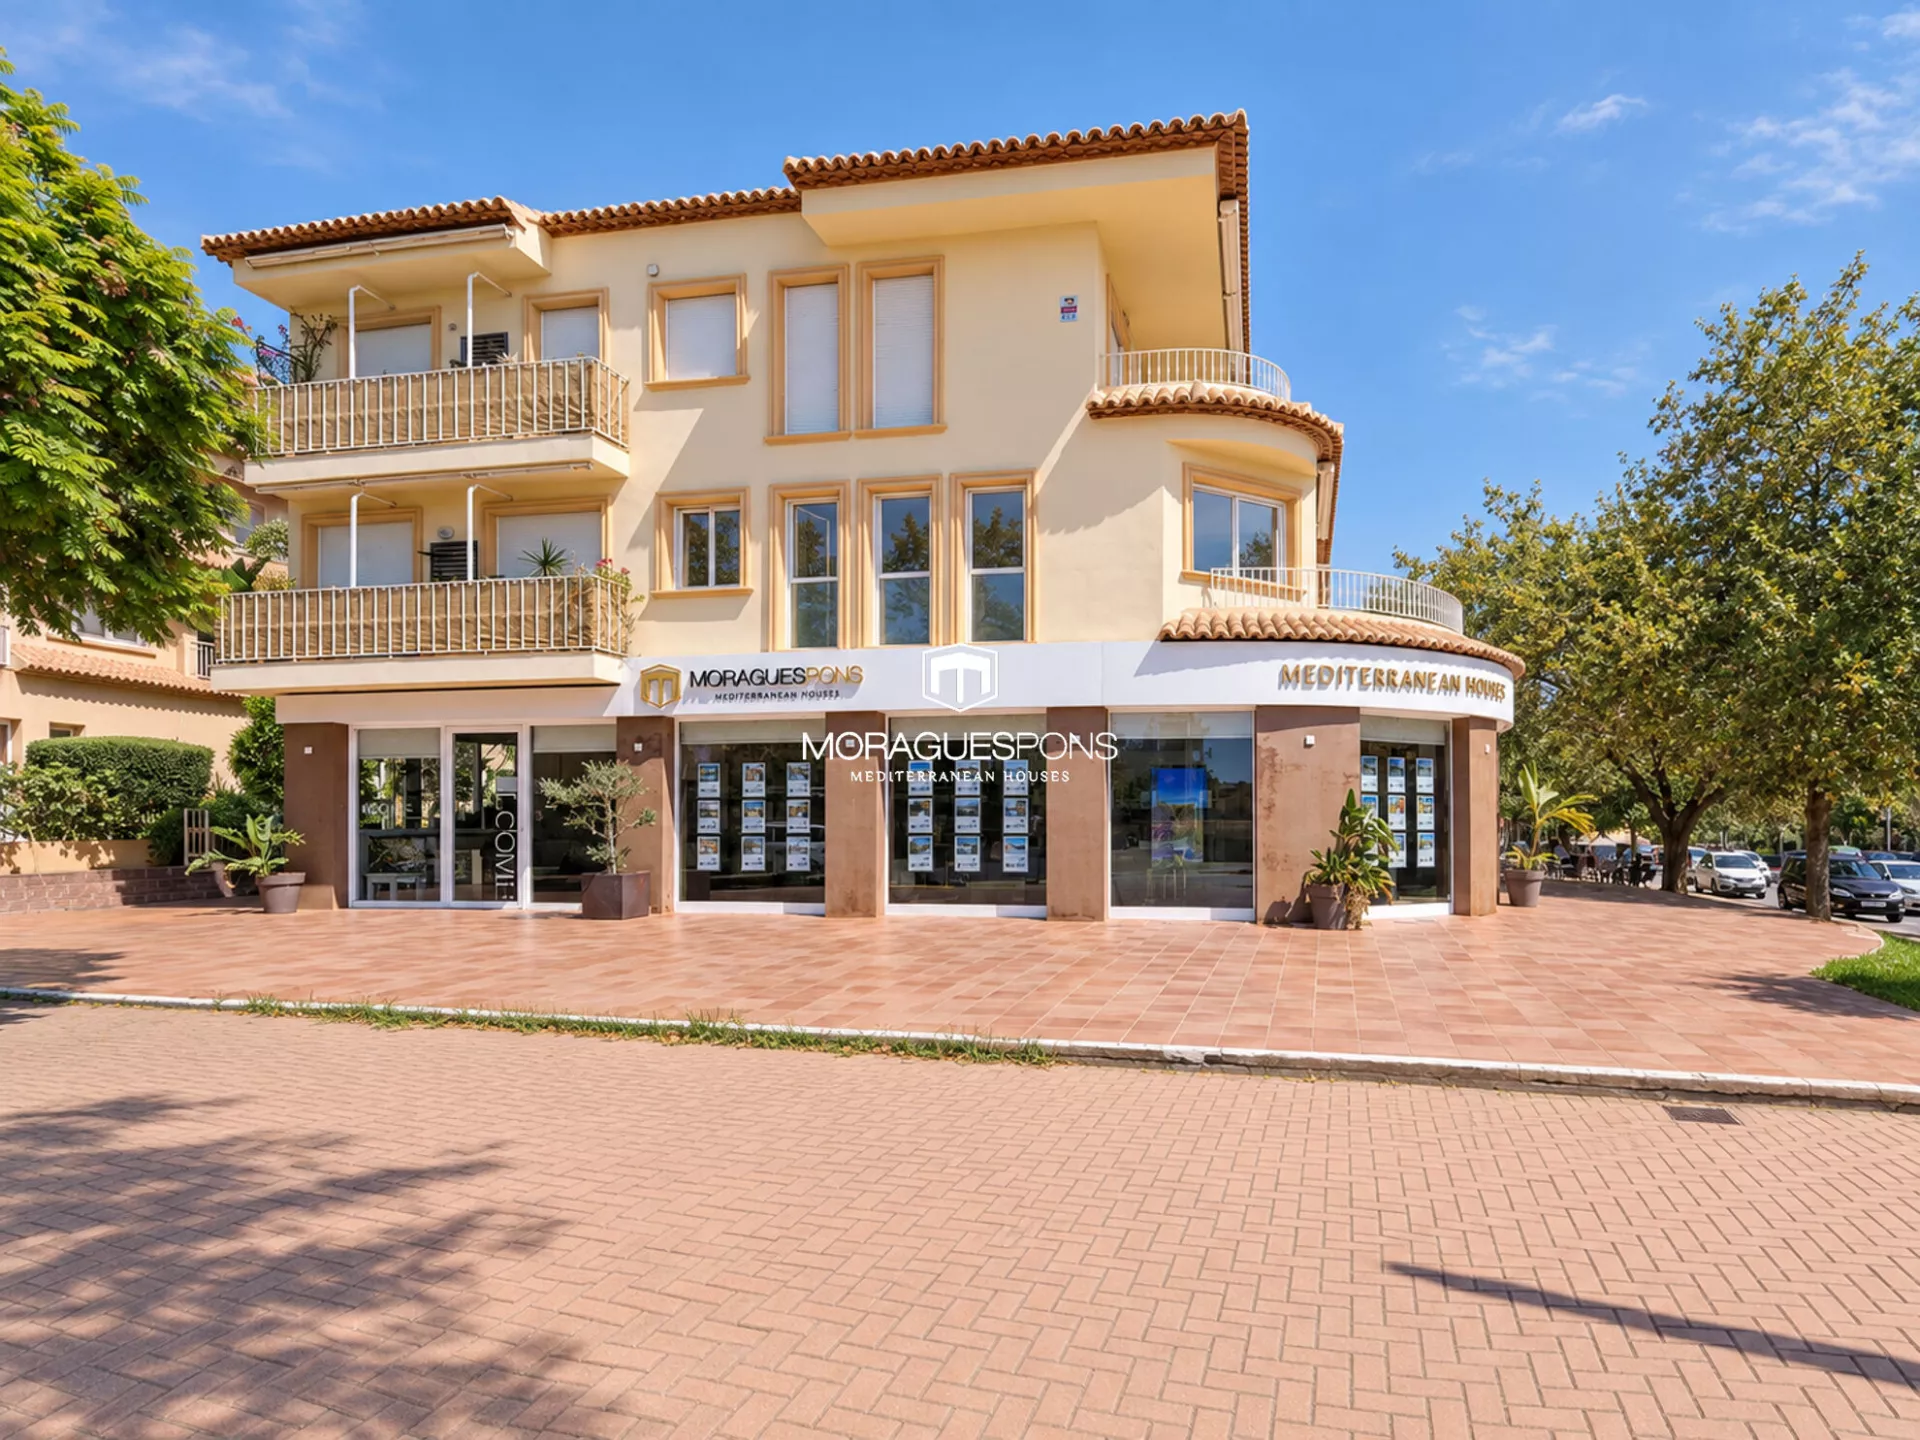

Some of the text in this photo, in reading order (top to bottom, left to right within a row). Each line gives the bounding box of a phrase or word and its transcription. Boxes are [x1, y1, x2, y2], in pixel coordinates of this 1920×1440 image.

[689, 665, 864, 688] MORAGUESPONS
[1281, 664, 1461, 692] MEDITERRANEAN
[714, 690, 840, 700] MEDITERRANEAN HOUSES
